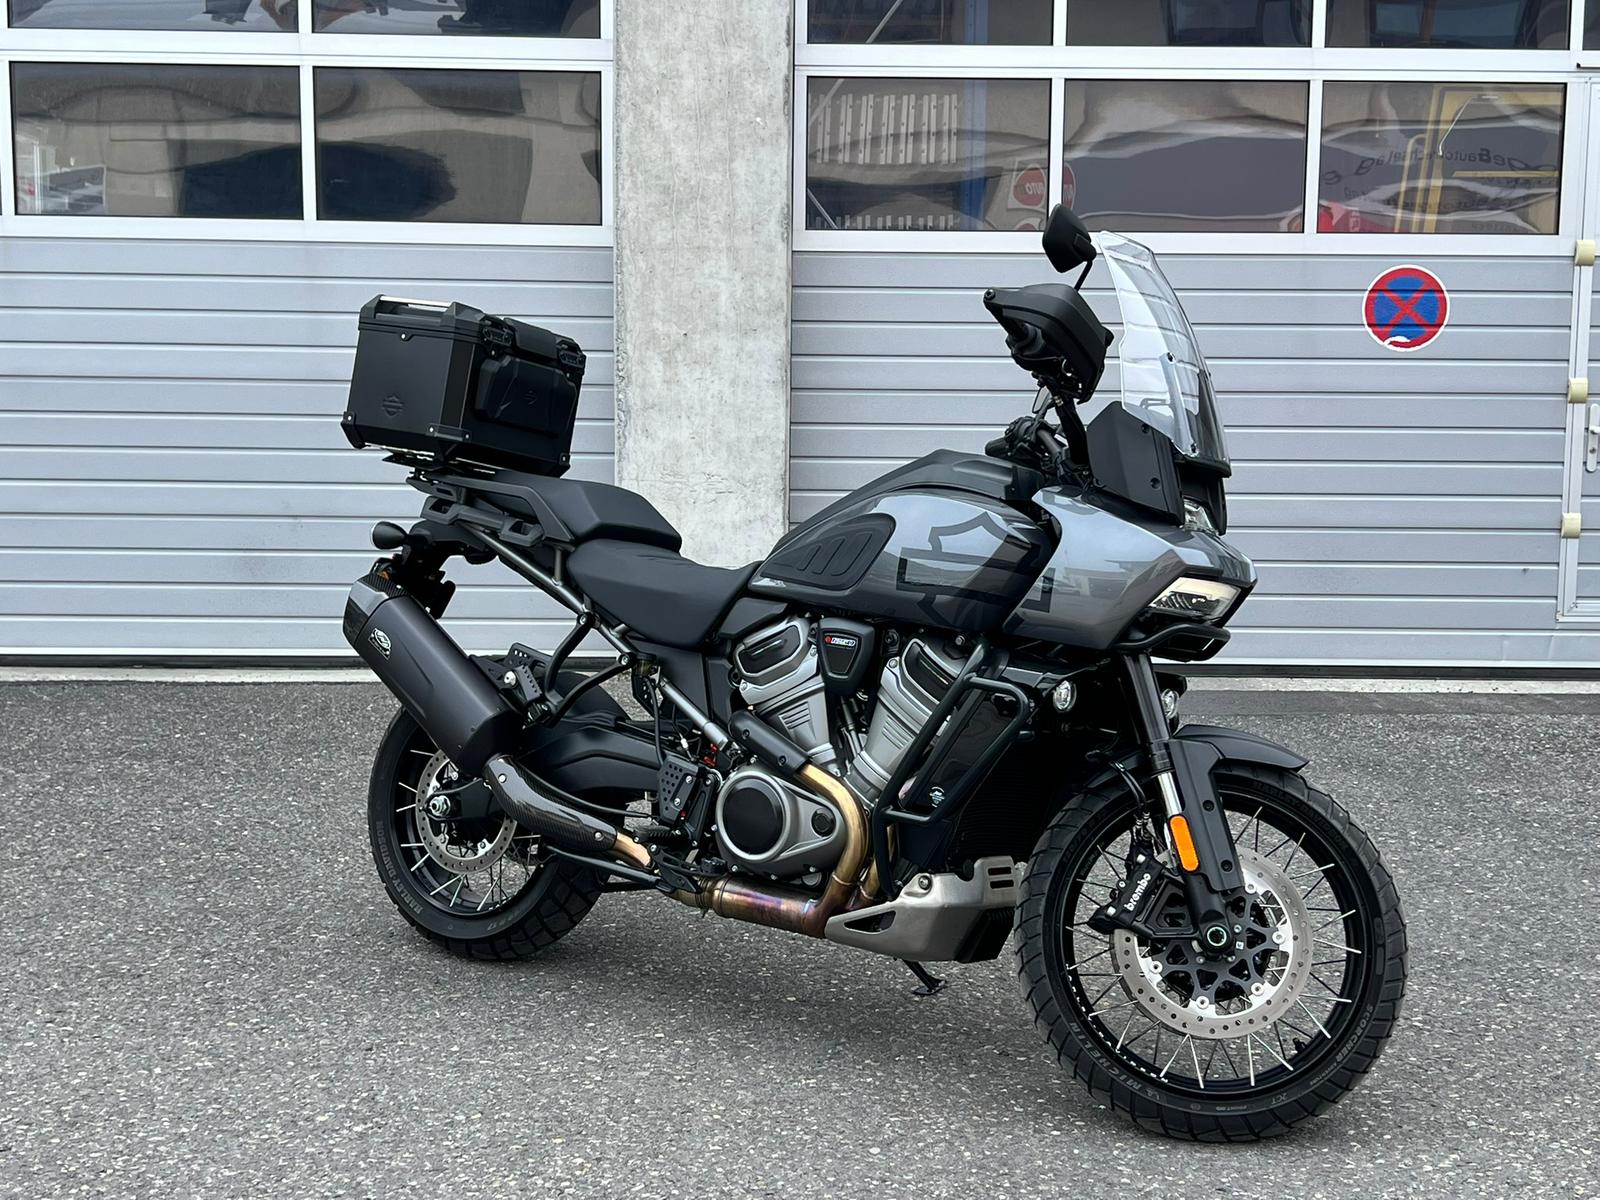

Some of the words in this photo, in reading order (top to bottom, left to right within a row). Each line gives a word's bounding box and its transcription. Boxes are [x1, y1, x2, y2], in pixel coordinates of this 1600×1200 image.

[1123, 872, 1152, 912] brembo
[1068, 1021, 1142, 1091] MICHELIN
[1335, 1003, 1374, 1063] SCORCHER
